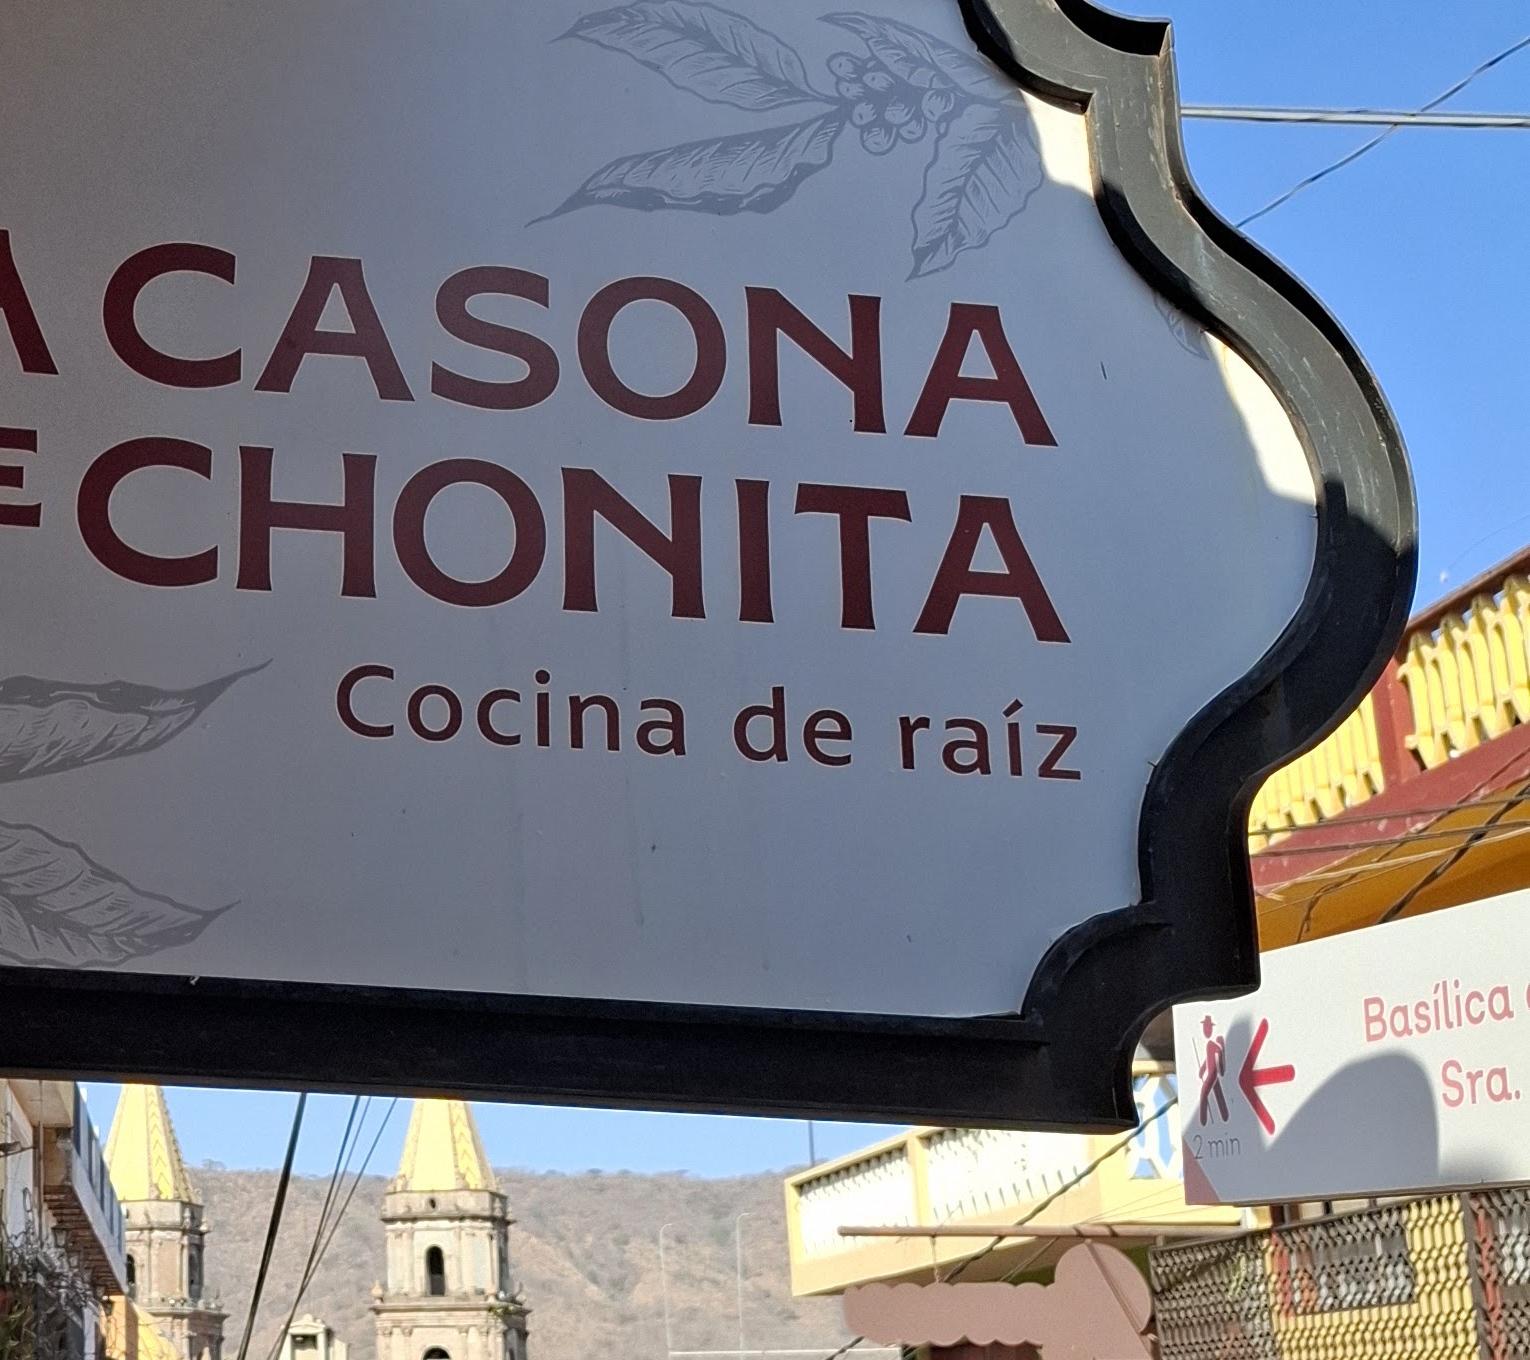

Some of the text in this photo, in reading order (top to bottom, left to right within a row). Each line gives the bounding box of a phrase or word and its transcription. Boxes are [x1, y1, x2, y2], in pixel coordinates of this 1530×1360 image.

[102, 242, 1059, 447] CASONA
[76, 436, 1071, 644] CHONITA
[336, 664, 1081, 781] Cocina de raíz
[1363, 978, 1514, 1042] Basílica
[1441, 1059, 1521, 1108] Sra.
[1193, 1132, 1241, 1159] 2 min
